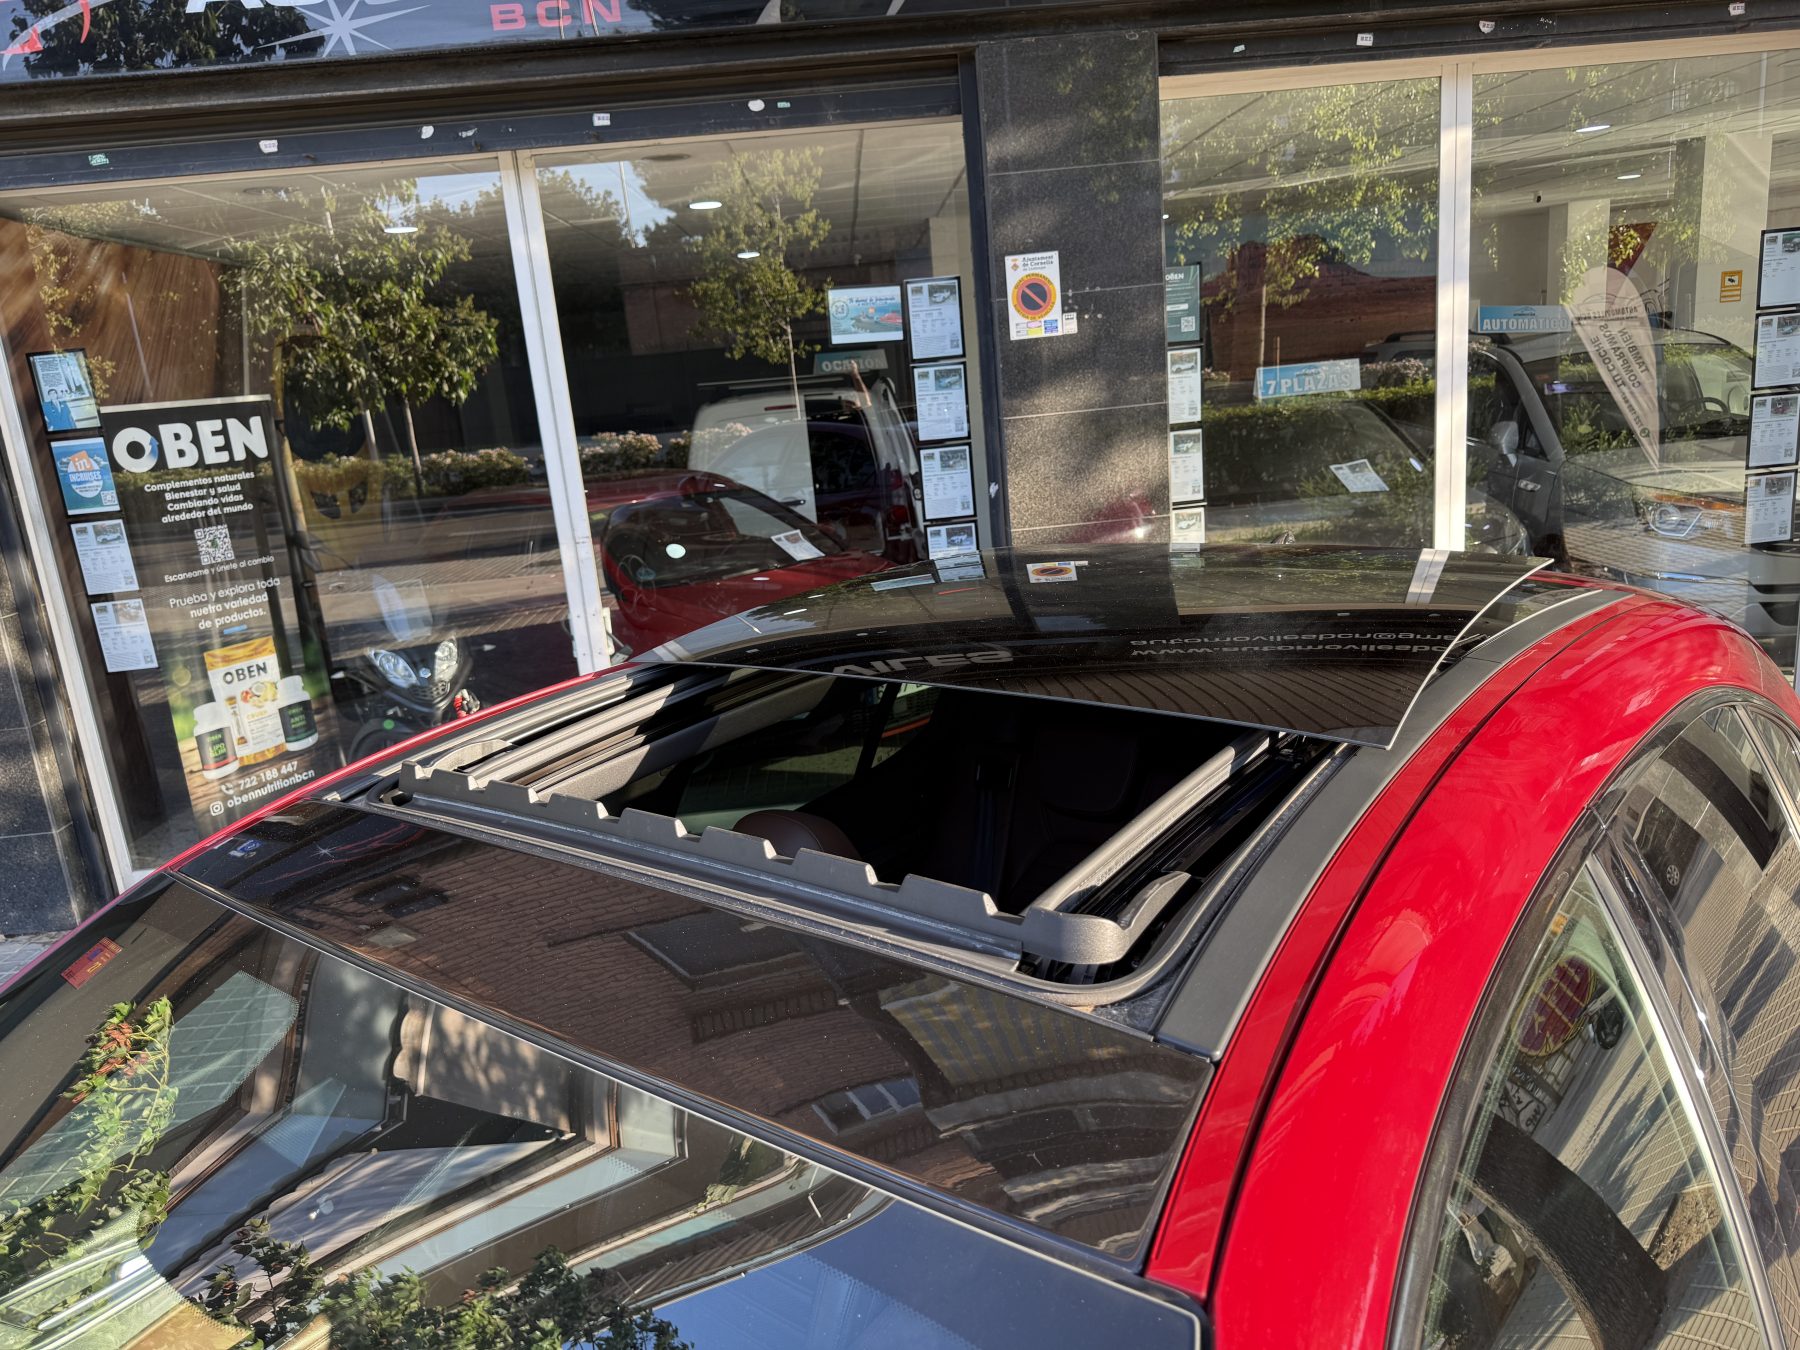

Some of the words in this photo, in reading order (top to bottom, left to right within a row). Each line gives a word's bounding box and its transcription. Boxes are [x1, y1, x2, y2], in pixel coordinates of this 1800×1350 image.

[490, 0, 622, 31] BCN
[1266, 380, 1276, 395] 7
[1281, 373, 1351, 393] PLAZAS
[112, 415, 269, 474] OBEN
[69, 470, 102, 483] INCRUISES
[144, 476, 213, 493] Complementos
[214, 471, 255, 483] naturales
[164, 488, 208, 501] Bienestar
[209, 487, 216, 496] y
[217, 482, 241, 494] salud
[167, 497, 219, 512] Cambiando
[220, 493, 245, 504] vidas
[161, 509, 206, 523] alrededor
[207, 506, 222, 516] del
[223, 502, 254, 514] mundo
[164, 568, 210, 583] Escaneame
[239, 559, 247, 568] al
[247, 555, 275, 566] cambio
[169, 592, 208, 609] Prueba
[210, 591, 217, 601] y
[218, 583, 256, 598] explora
[257, 577, 281, 589] toda
[190, 603, 223, 618] nuetra
[224, 592, 269, 610] variedad
[198, 619, 212, 630] de
[214, 607, 267, 628] productos.
[222, 661, 268, 685] OBEN
[239, 776, 258, 790] 722
[260, 768, 279, 783] 188
[280, 761, 298, 775] 447
[227, 769, 316, 808] obennutritionbcn
